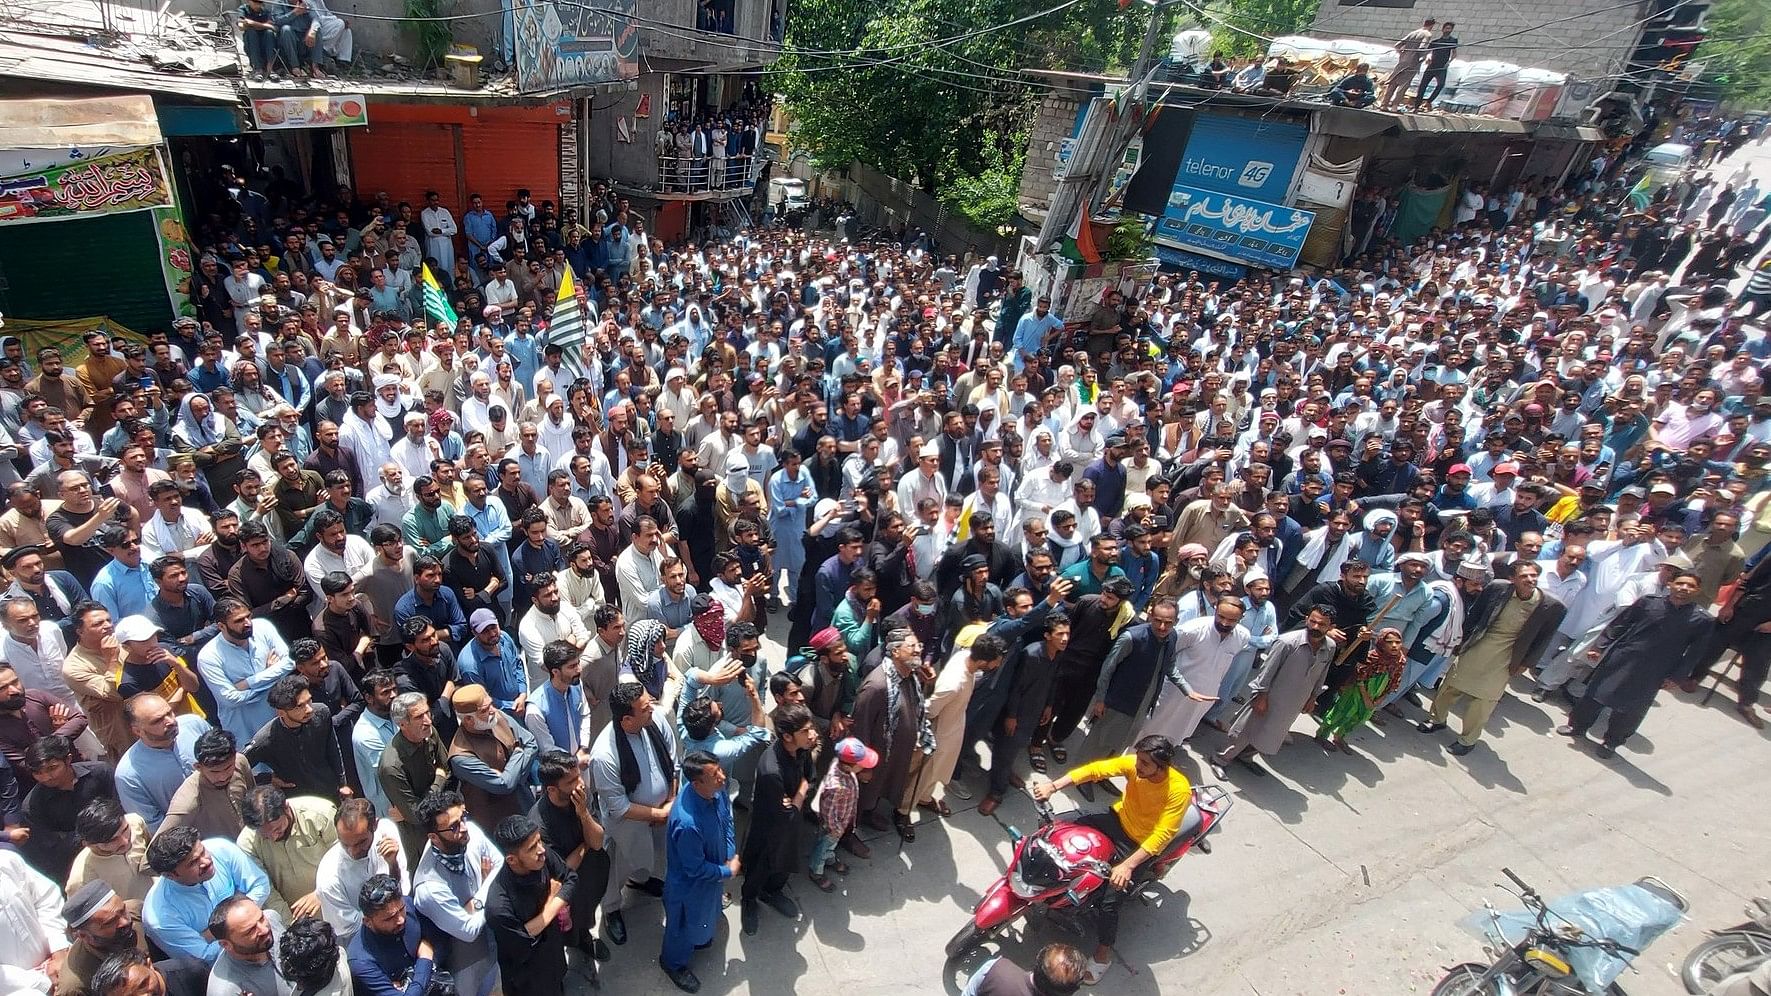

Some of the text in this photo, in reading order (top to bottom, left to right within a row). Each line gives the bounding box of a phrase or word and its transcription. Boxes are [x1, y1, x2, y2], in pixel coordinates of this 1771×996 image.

[1186, 158, 1269, 182] telenor 4G
[1185, 196, 1310, 234] عثمان پولٹری فارم
